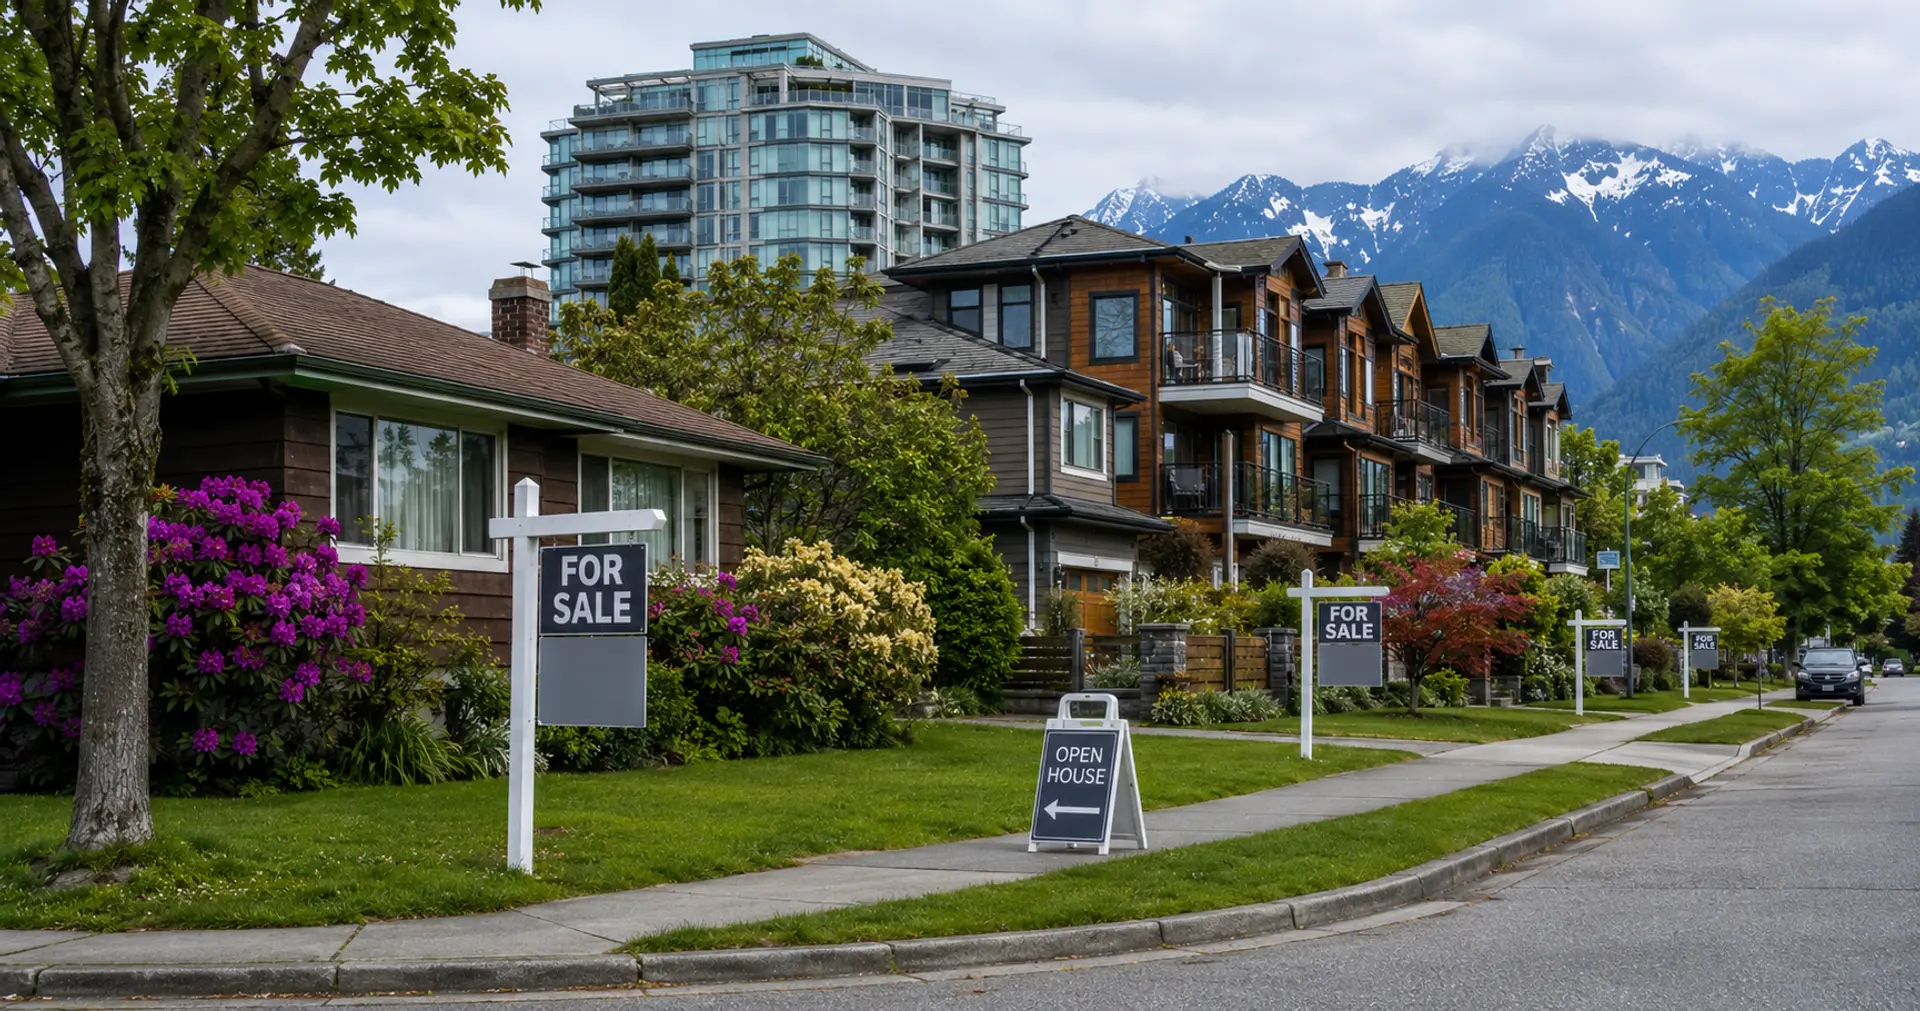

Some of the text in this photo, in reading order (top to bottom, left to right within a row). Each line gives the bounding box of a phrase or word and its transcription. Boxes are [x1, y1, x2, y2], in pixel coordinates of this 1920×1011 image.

[561, 554, 623, 586] FOR
[553, 590, 632, 625] SALE
[1330, 605, 1368, 622] FOR
[1325, 623, 1374, 639] SALE
[1592, 630, 1615, 640] FOR
[1590, 640, 1619, 650] SALE
[1694, 641, 1715, 650] SALE
[1055, 746, 1104, 763] OPEN
[1047, 767, 1106, 784] HOUSE
